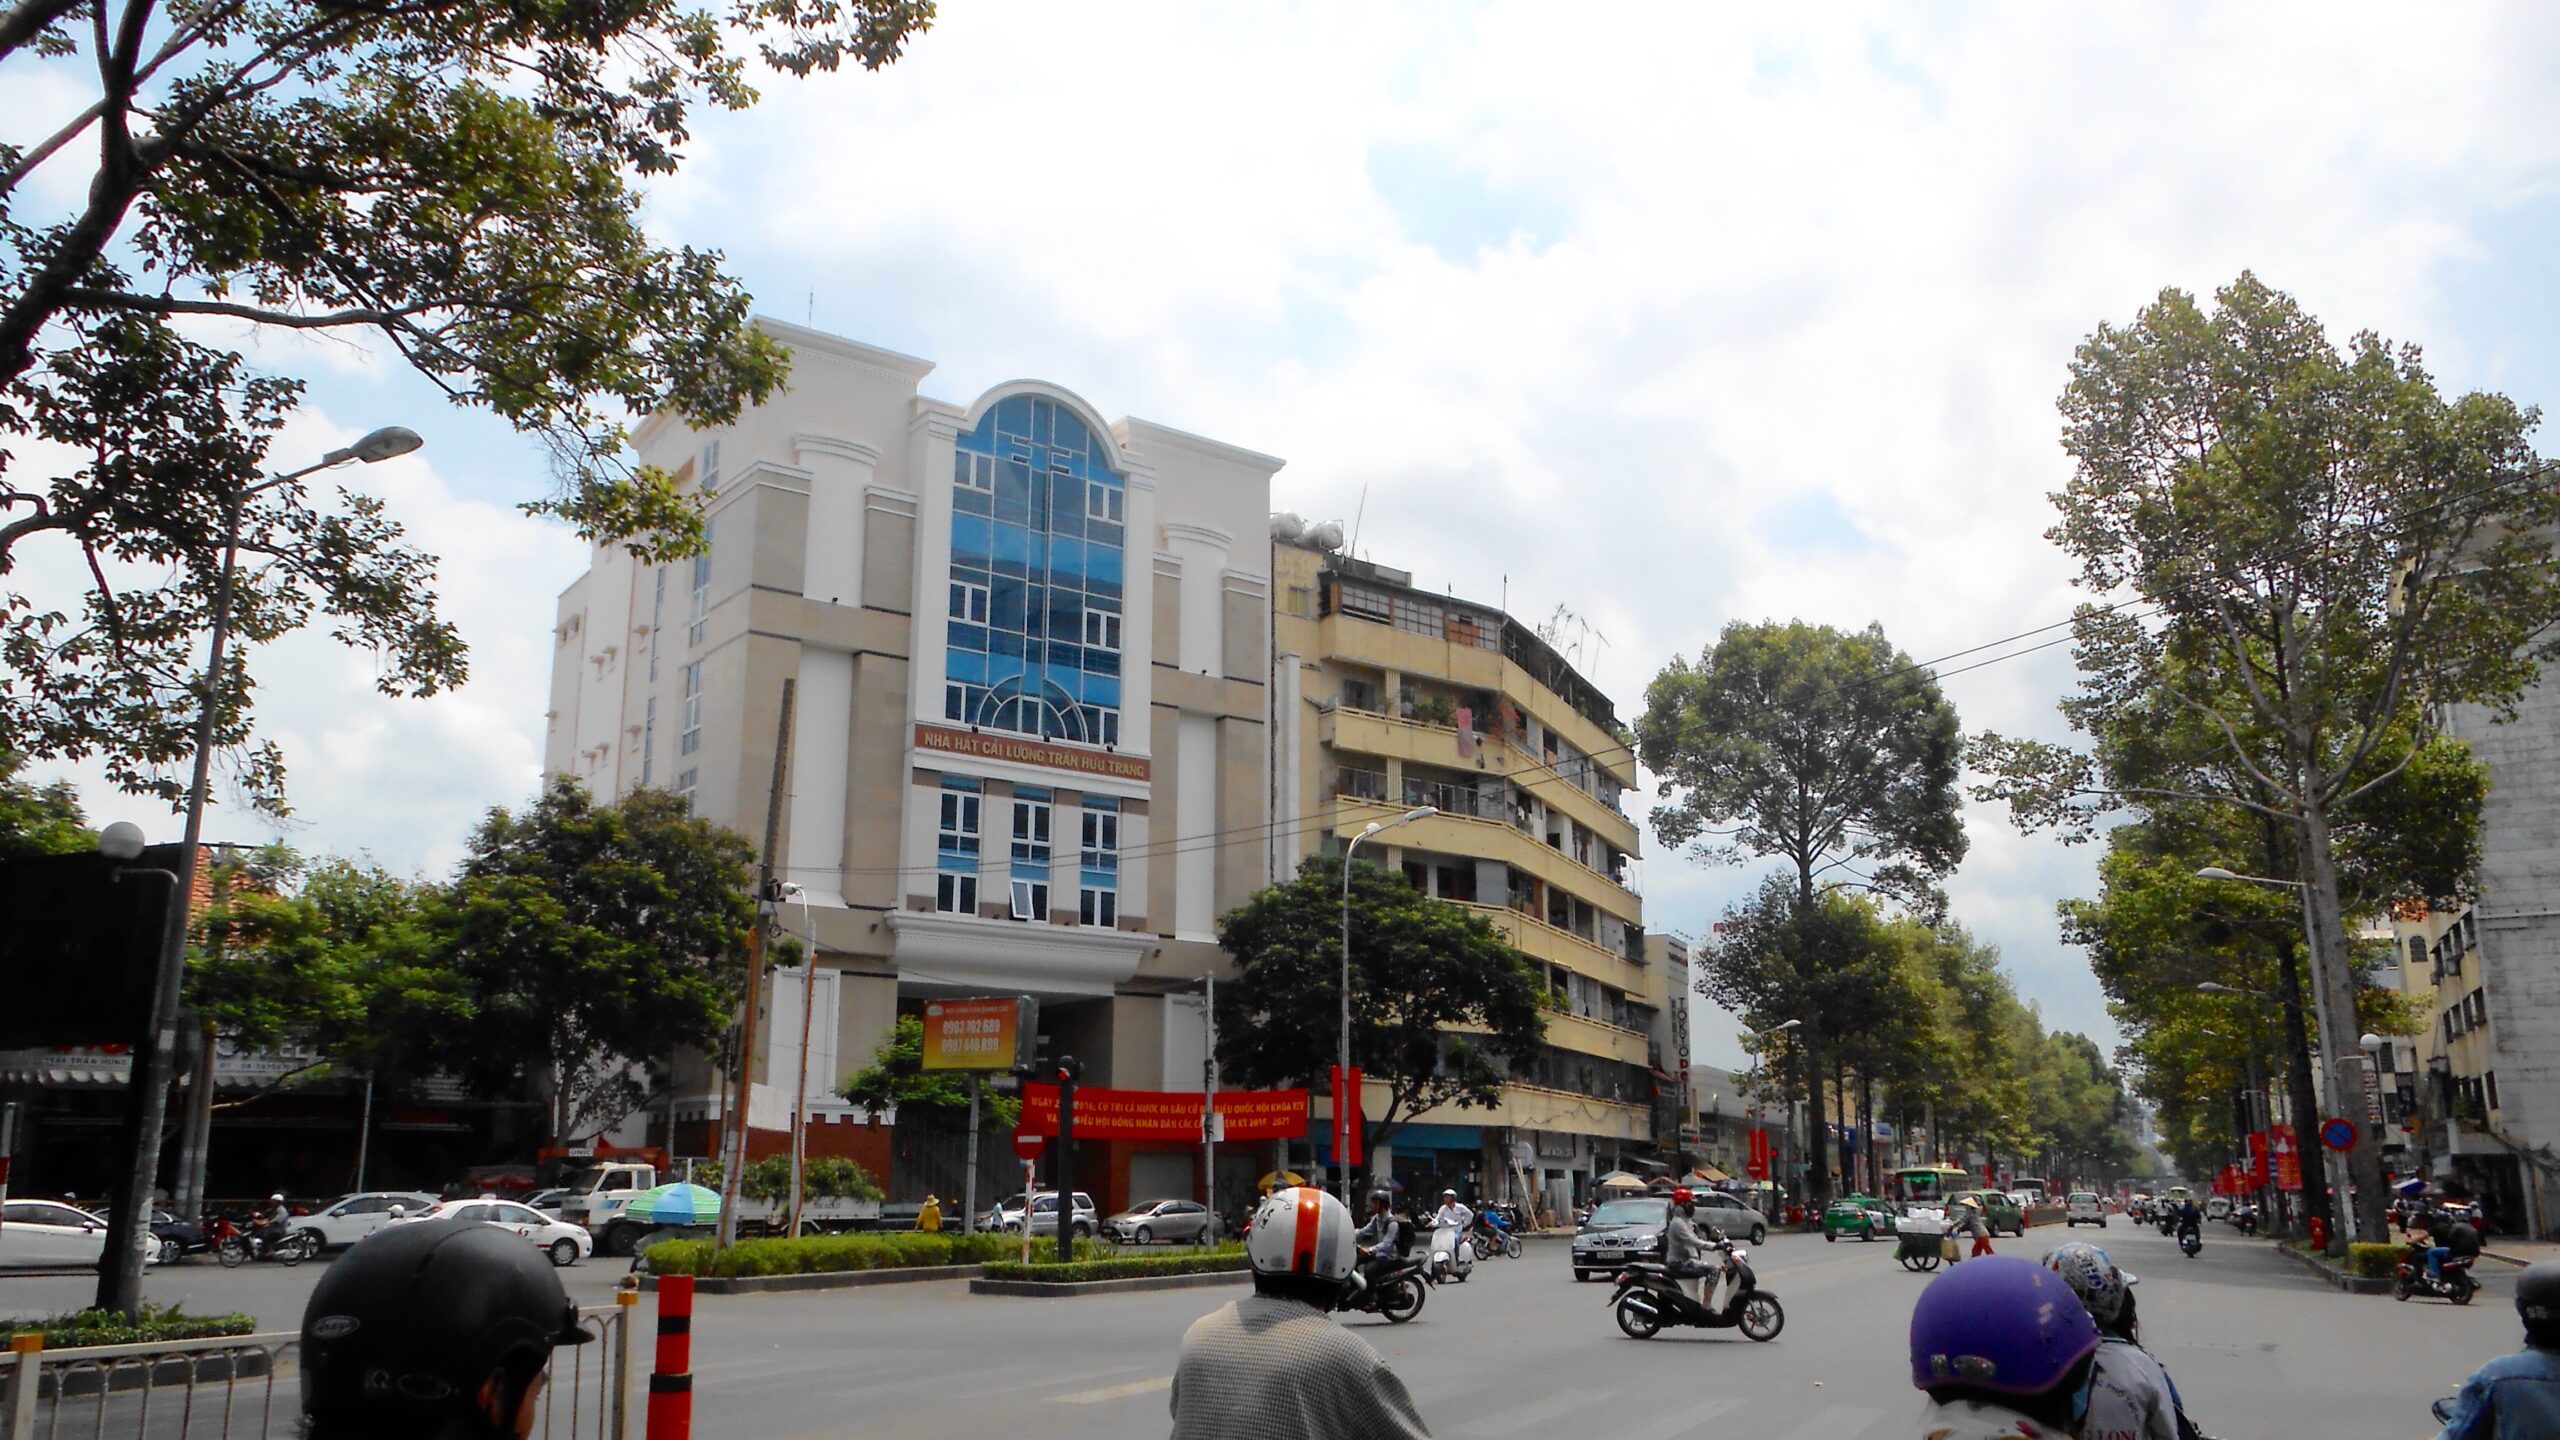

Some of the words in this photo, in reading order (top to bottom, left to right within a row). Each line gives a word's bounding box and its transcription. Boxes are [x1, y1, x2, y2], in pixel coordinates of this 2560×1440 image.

[924, 732, 950, 749] NHÀ
[955, 736, 978, 752] HÁT
[982, 738, 1003, 756] CẢI
[1006, 744, 1044, 762] LƯƠNG
[1107, 761, 1144, 777] TRANG
[1031, 1096, 1053, 1107] NGÀY
[1111, 1102, 1124, 1112] TRI
